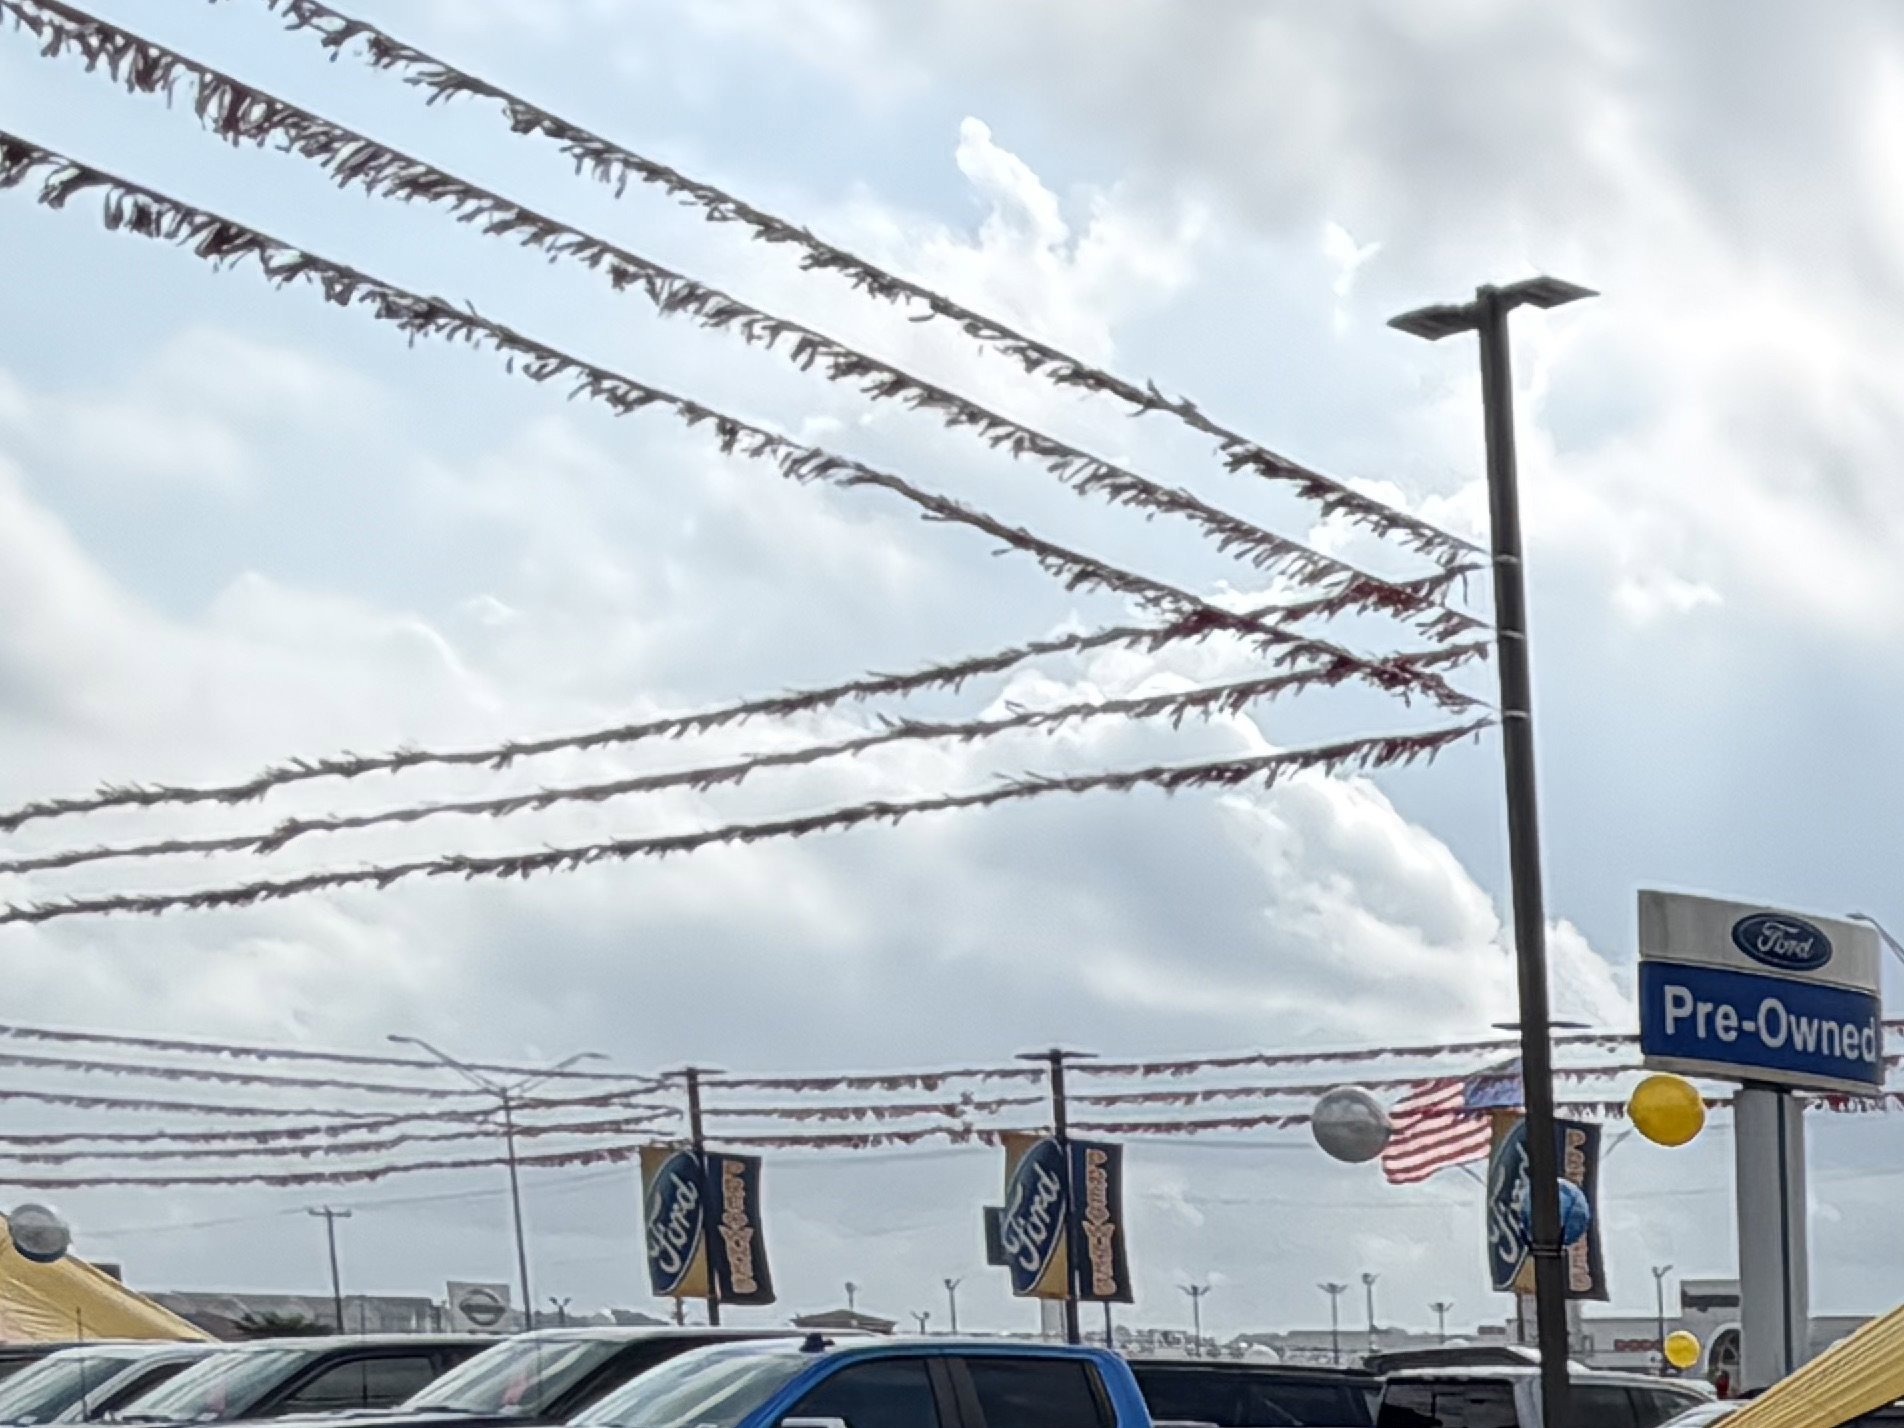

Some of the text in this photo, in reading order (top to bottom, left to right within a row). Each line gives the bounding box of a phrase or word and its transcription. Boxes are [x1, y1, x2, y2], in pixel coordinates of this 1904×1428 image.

[1756, 922, 1815, 959] Ford
[1663, 984, 1876, 1063] Pre-Owned
[649, 1171, 699, 1274] Ford
[1002, 1161, 1061, 1272] Ford
